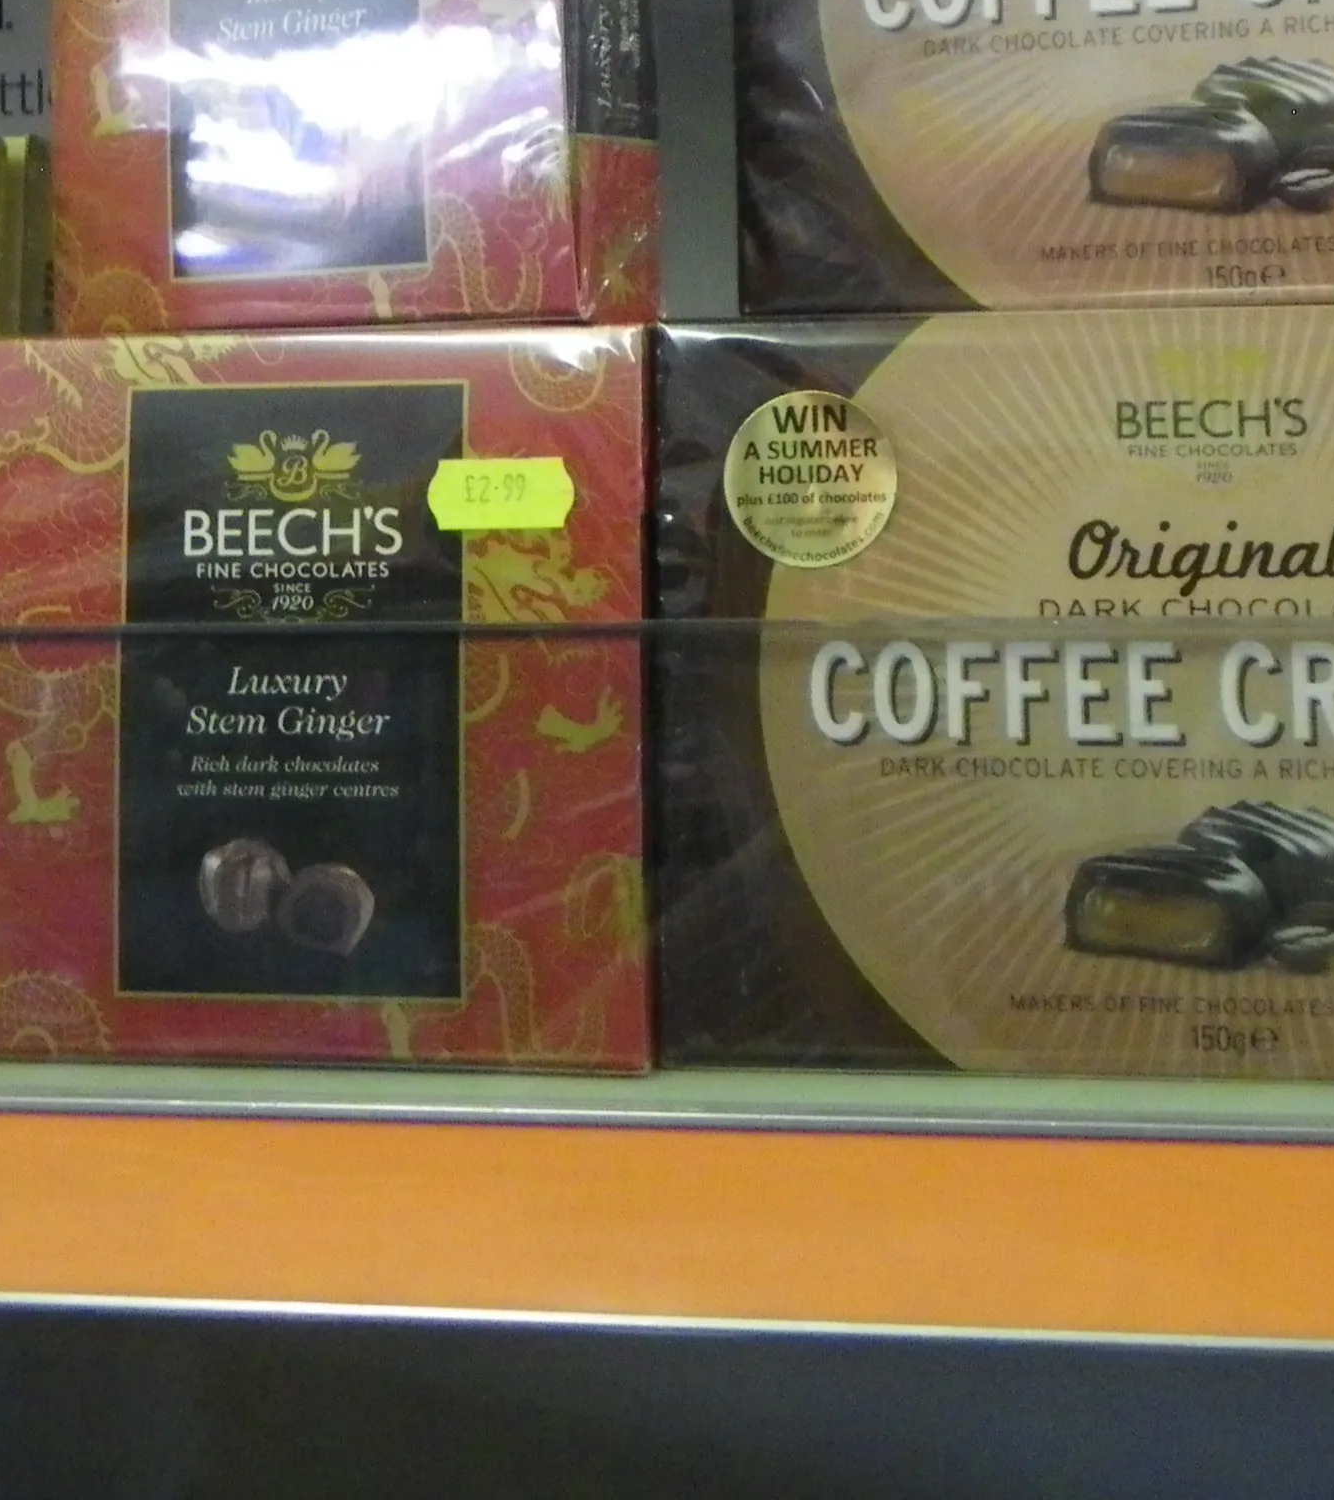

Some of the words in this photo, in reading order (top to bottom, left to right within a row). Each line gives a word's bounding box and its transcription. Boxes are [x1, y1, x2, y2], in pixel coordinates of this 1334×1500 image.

[218, 15, 273, 42] Stem
[283, 7, 367, 35] Ginger
[923, 36, 980, 58] DARK
[991, 27, 1123, 52] CHOCOLATE
[1132, 17, 1250, 44] COVERING
[1259, 18, 1274, 36] A
[1040, 243, 1118, 261] MAKERS
[1124, 242, 1153, 260] OF
[1157, 240, 1198, 258] FINE
[772, 404, 848, 434] WIN
[1115, 398, 1308, 440] BEECH'S
[744, 442, 760, 460] A
[767, 438, 878, 460] SUMMER
[1128, 444, 1167, 458] FINE
[1176, 443, 1298, 458] CHOCOLATES
[759, 463, 864, 485] HOLIDAY
[737, 494, 763, 508] plus
[768, 493, 798, 504] £100
[802, 492, 816, 504] of
[818, 491, 887, 504] chocolates
[184, 505, 403, 556] BEECH'S
[196, 562, 241, 579] FINE
[250, 561, 390, 579] CHOCOLATES
[273, 583, 311, 593] SINCE
[271, 594, 314, 611] 1920
[227, 666, 347, 701] Luxury
[809, 639, 1187, 747] COFFEE
[186, 705, 267, 735] Stem
[278, 705, 391, 741] Ginger
[191, 755, 230, 773] Rich
[235, 755, 279, 773] dark
[284, 755, 380, 773] chocolates
[880, 757, 947, 779] DARK
[954, 757, 1101, 780] CHOCOLATE
[1114, 757, 1243, 780] COVERING
[1253, 760, 1267, 780] A
[177, 780, 217, 797] with
[223, 783, 265, 797] stem
[269, 781, 328, 801] ginger
[332, 783, 400, 798] centres
[1010, 994, 1096, 1014] MAKERS
[1195, 997, 1333, 1017] CHOCOLATES
